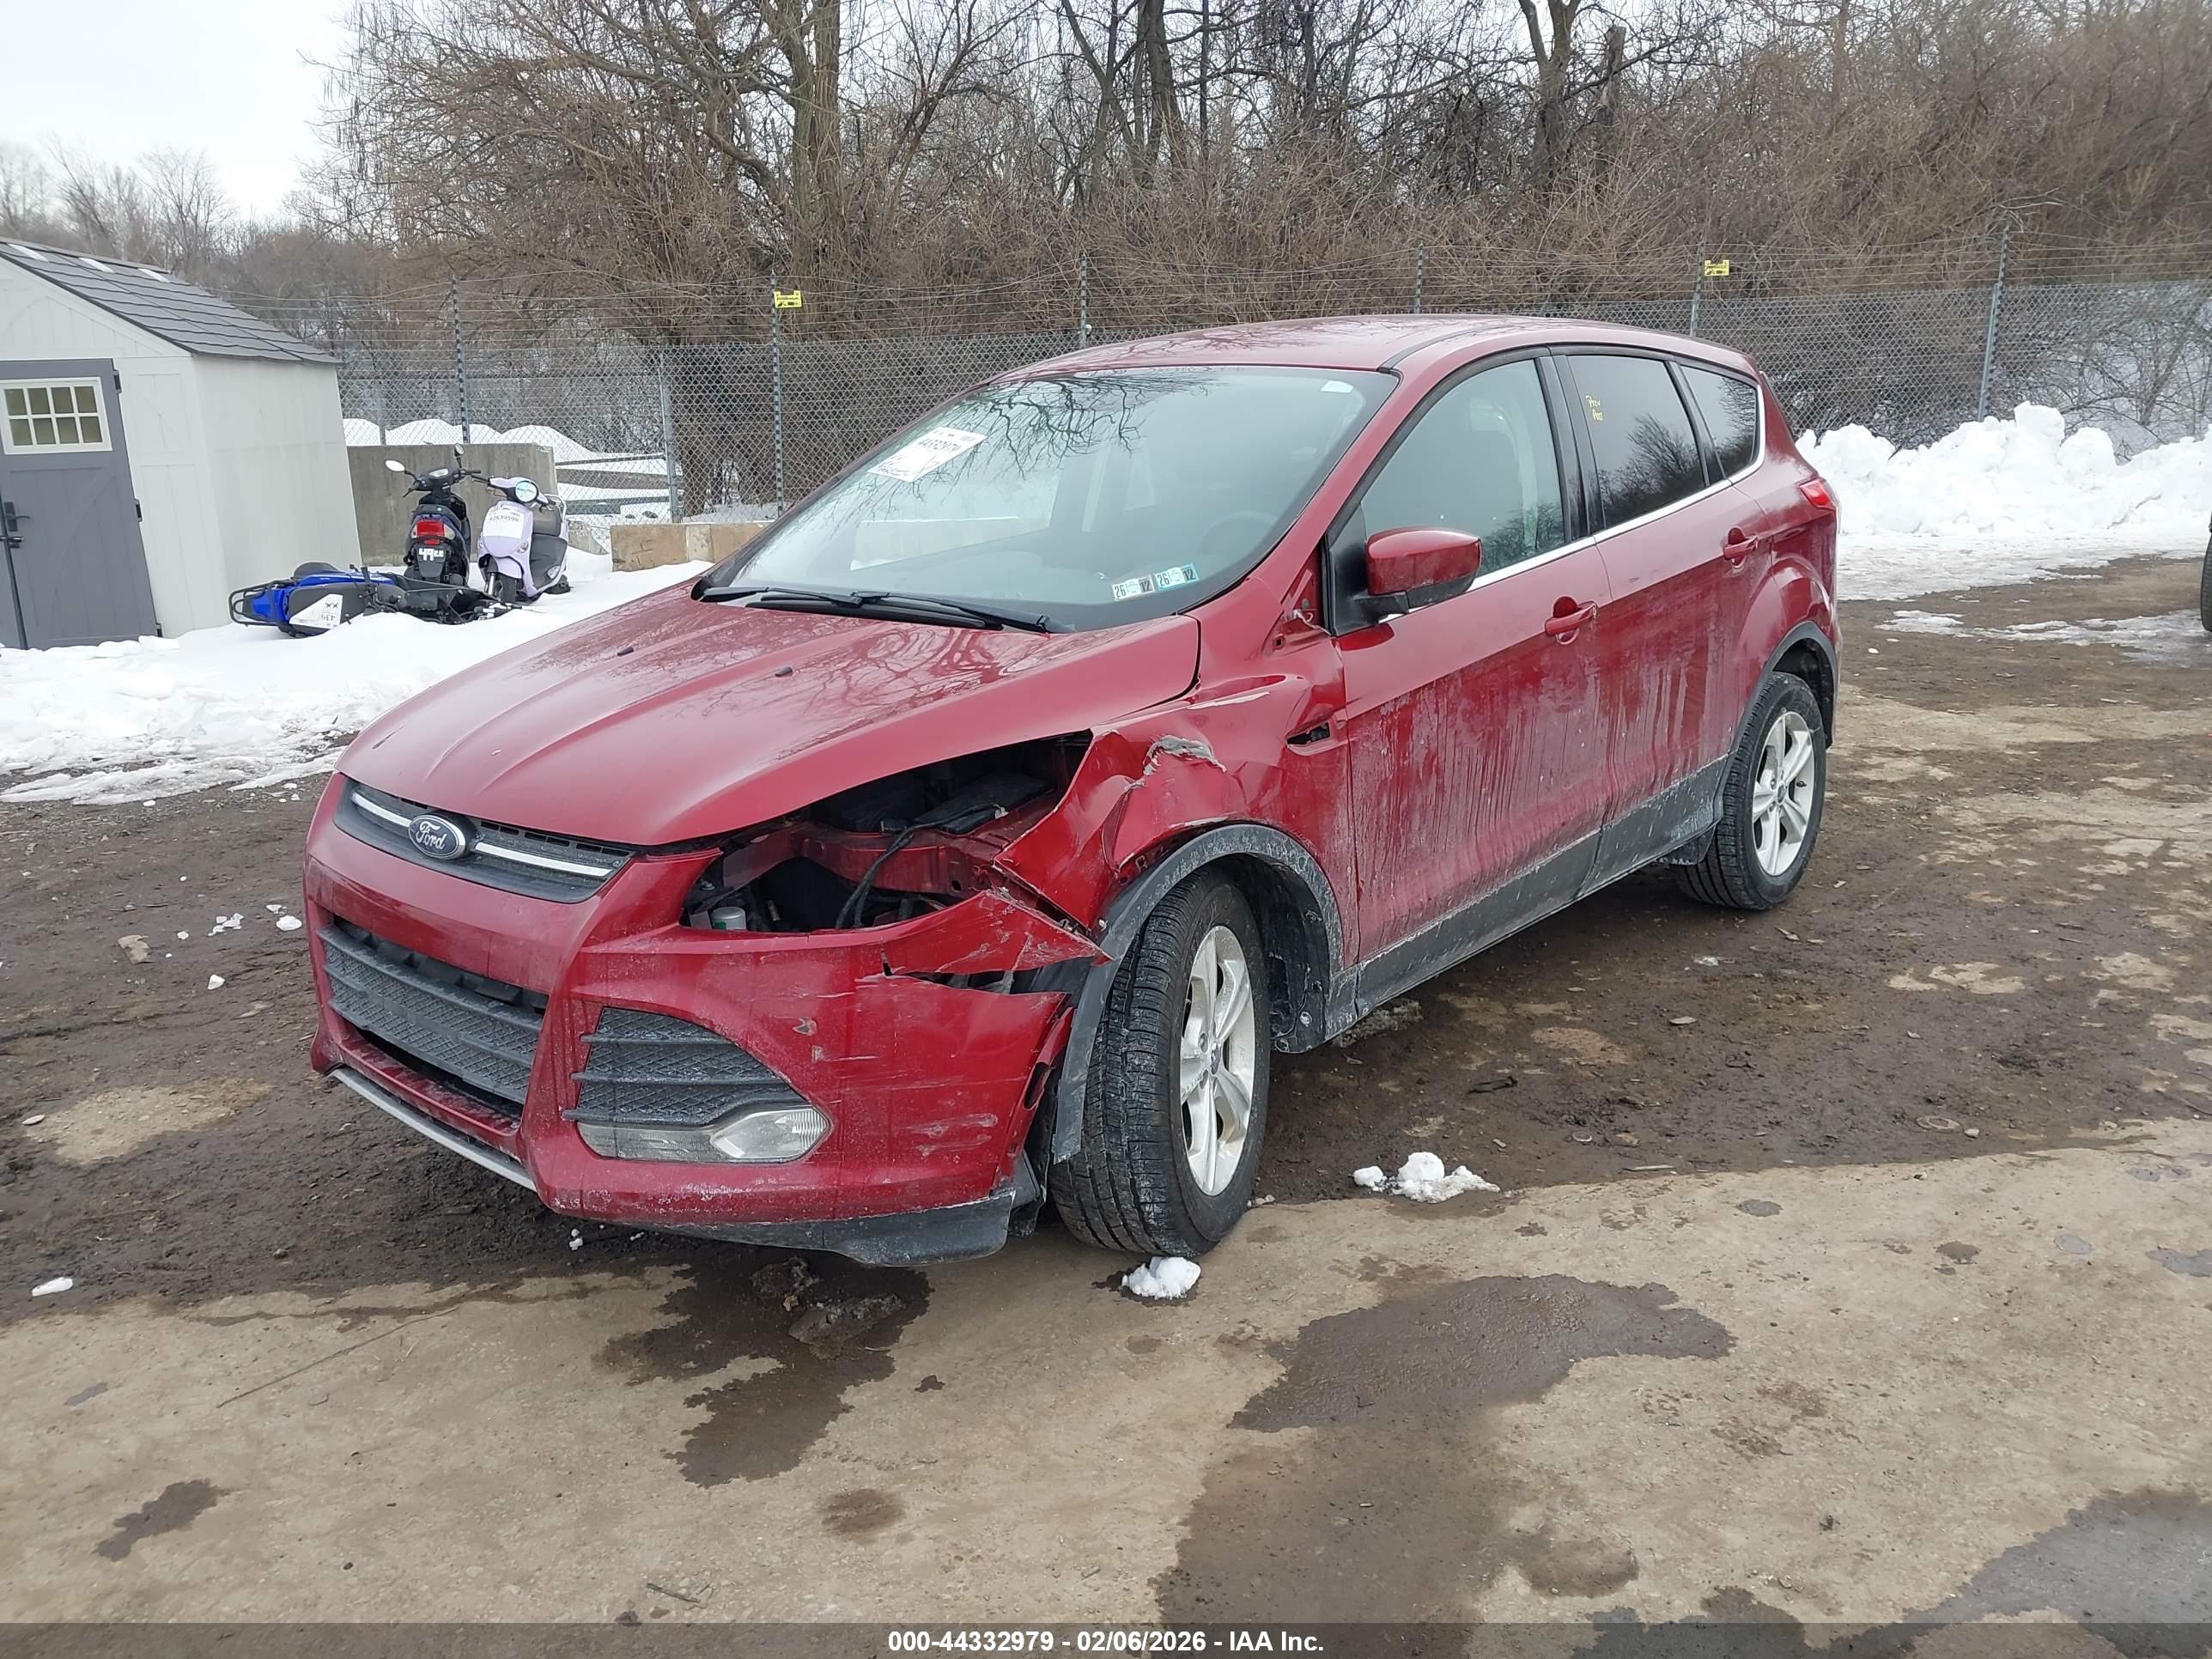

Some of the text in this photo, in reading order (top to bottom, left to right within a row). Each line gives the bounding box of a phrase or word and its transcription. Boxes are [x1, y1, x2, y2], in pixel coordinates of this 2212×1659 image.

[1158, 573, 1170, 586] 26
[1182, 568, 1196, 581] 12
[1114, 584, 1127, 598] 26
[1139, 579, 1151, 592] 12
[416, 820, 447, 850] Ford
